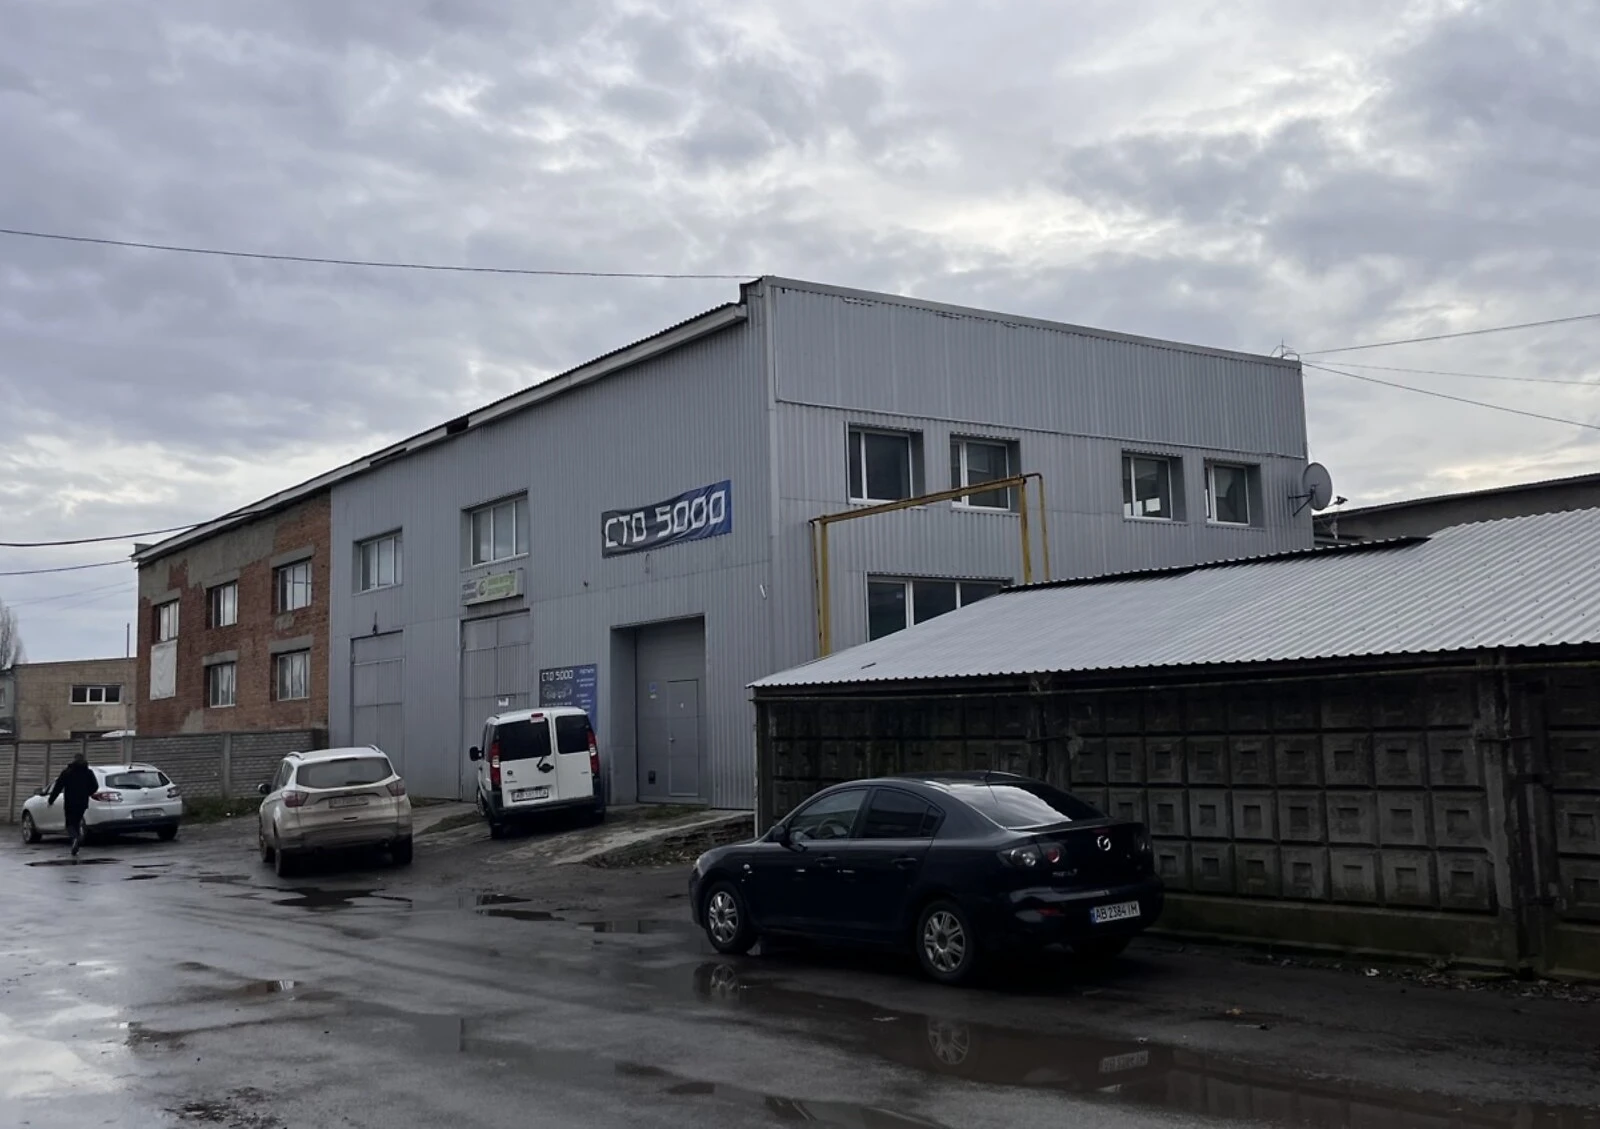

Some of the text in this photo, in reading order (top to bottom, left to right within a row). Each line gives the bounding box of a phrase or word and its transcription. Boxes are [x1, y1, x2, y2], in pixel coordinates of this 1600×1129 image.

[605, 490, 726, 548] СТО 5000
[555, 669, 573, 681] 5000
[1096, 907, 1108, 920] AB
